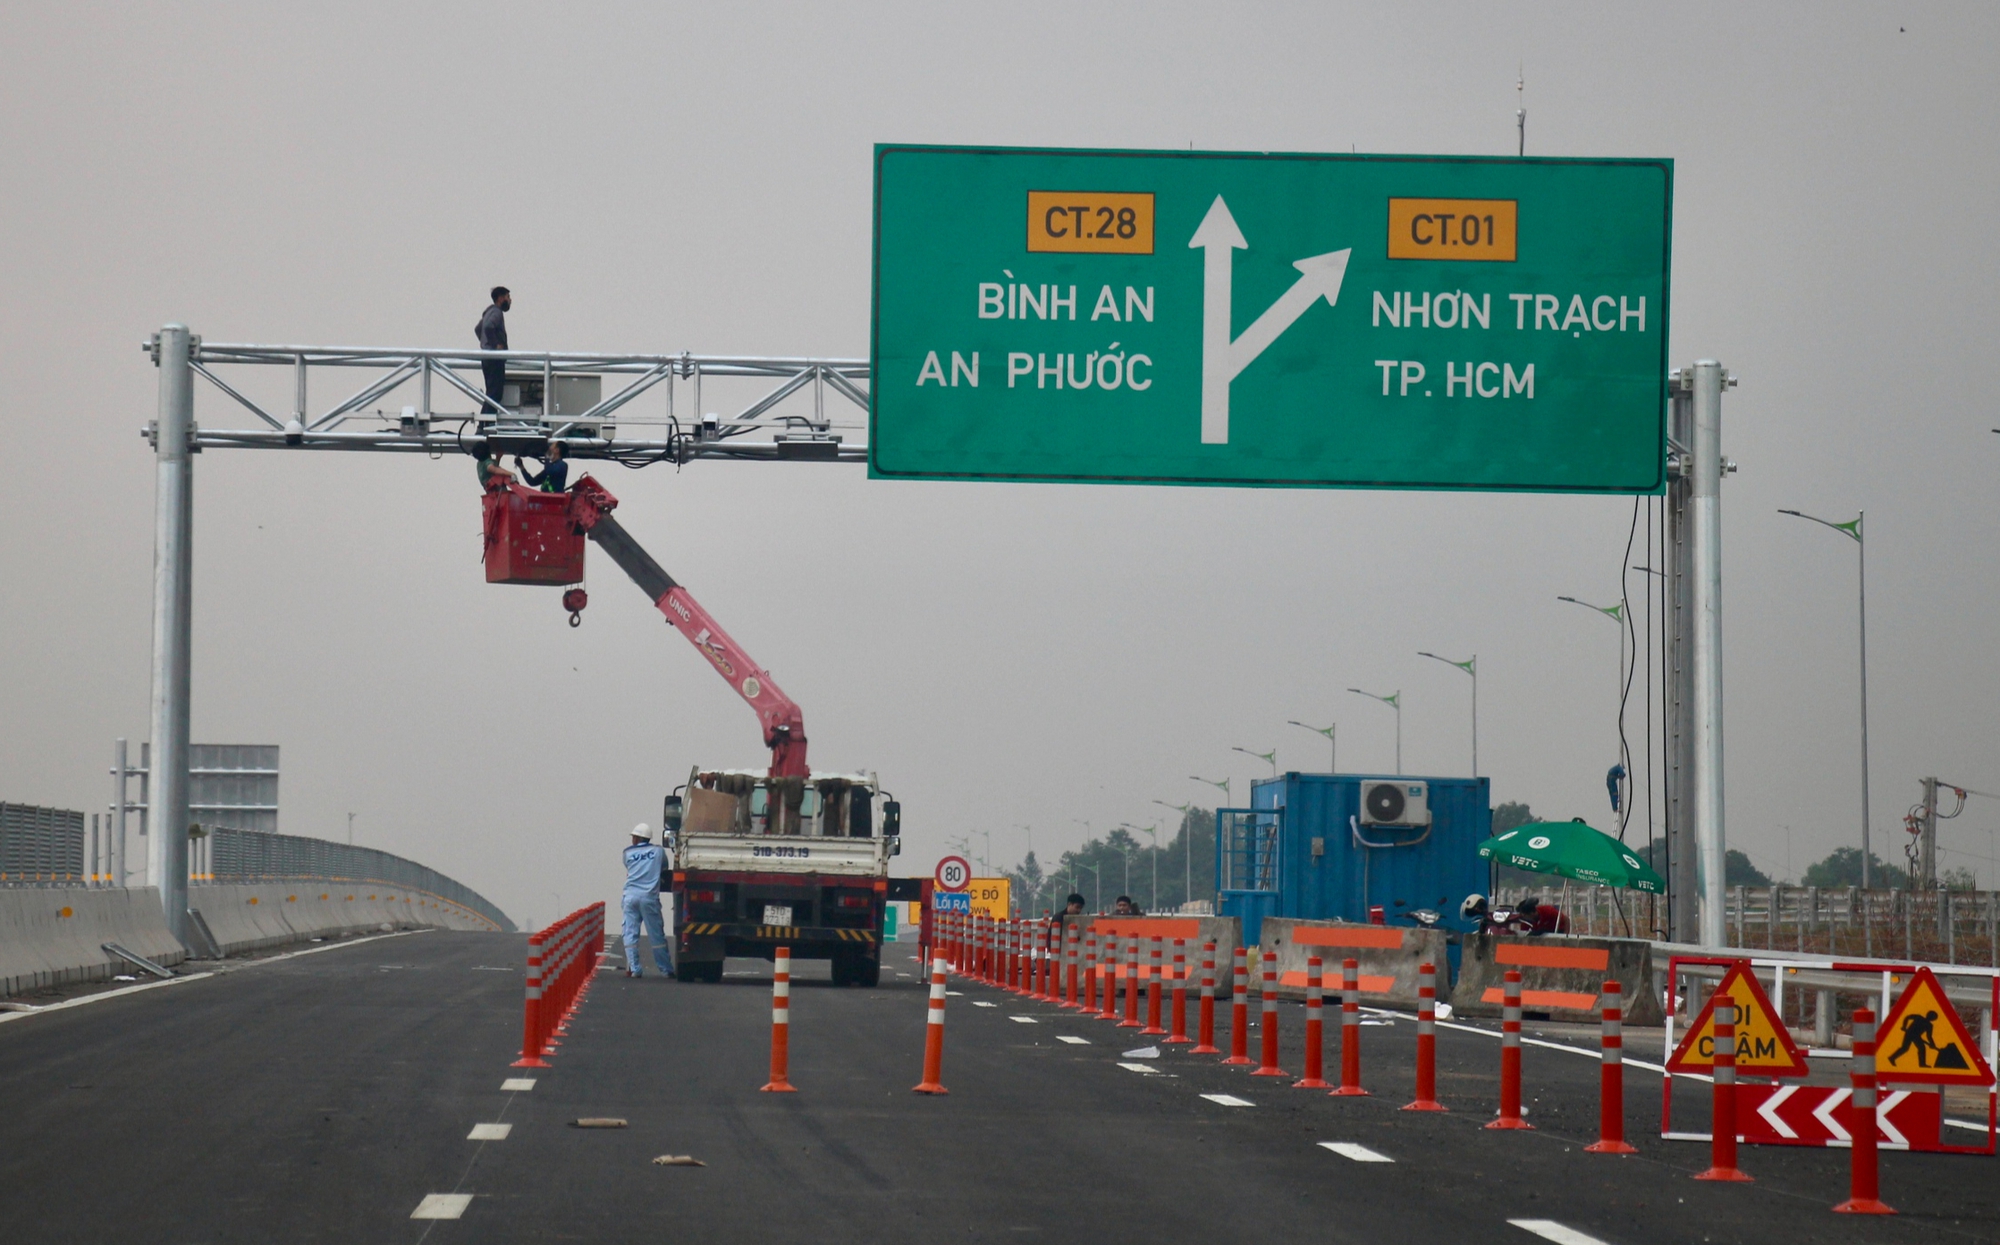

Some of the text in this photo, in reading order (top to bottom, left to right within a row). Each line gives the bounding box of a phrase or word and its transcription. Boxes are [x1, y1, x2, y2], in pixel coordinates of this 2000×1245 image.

[1045, 205, 1138, 240] CT.28
[1411, 213, 1495, 247] CT.01
[978, 268, 1155, 323] BÌNH AN
[1372, 288, 1646, 338] NHƠN TRẠCH
[917, 341, 1153, 391] AN PHƯỚC
[1375, 359, 1535, 399] TP. HCM
[669, 595, 691, 623] UNIC
[945, 866, 961, 882] 80
[1511, 855, 1539, 869] VETC
[1575, 868, 1599, 876] TASCO
[936, 893, 951, 909] LỐI
[953, 899, 968, 910] RA
[1698, 1031, 1775, 1064] CẬM
